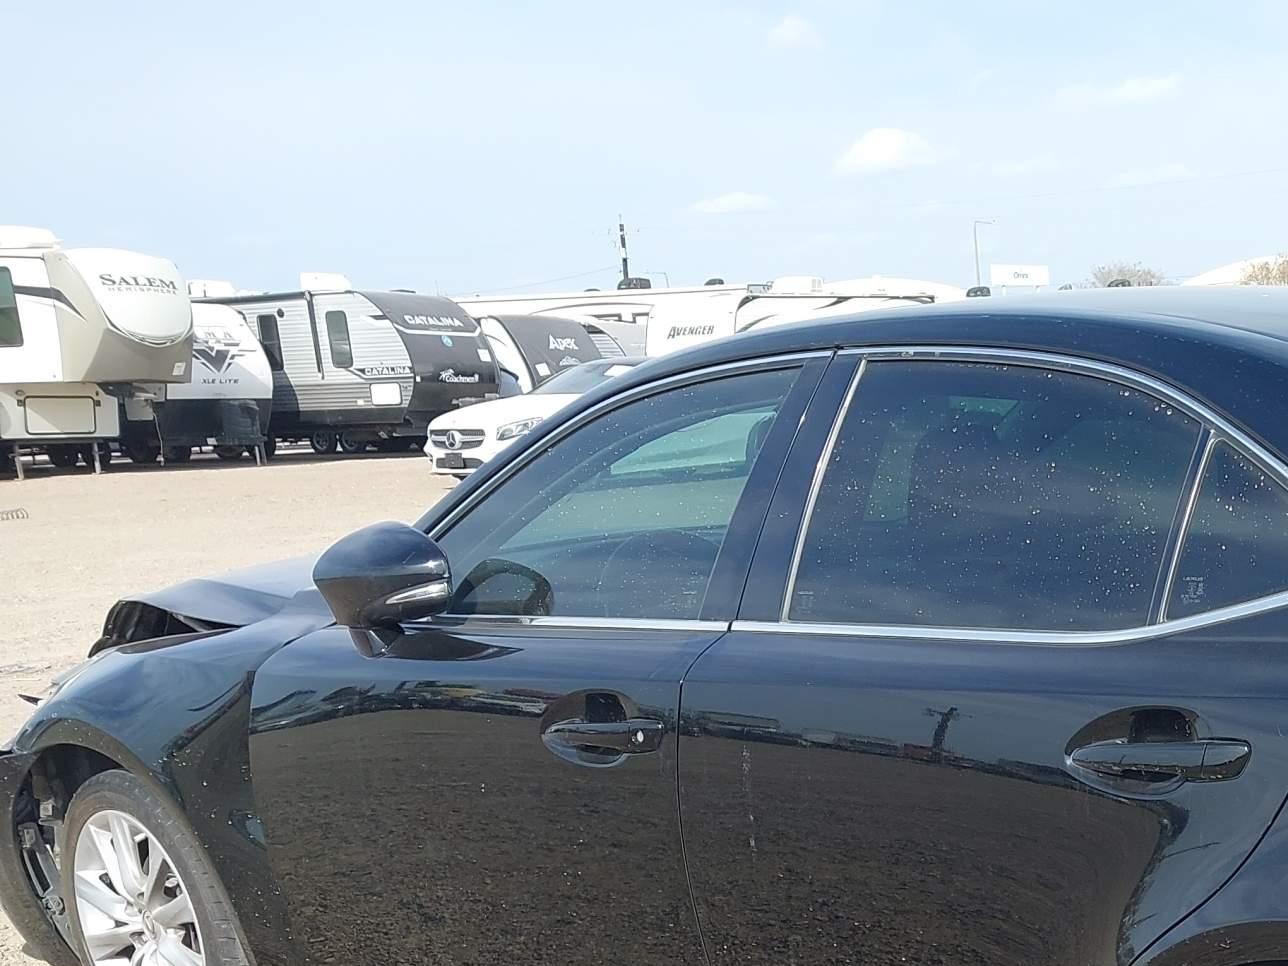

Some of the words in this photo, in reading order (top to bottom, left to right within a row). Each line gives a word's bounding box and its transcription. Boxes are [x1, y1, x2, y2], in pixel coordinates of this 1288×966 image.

[99, 273, 177, 289] SALEM
[403, 314, 465, 327] CATALINA
[365, 366, 411, 376] CATALINA
